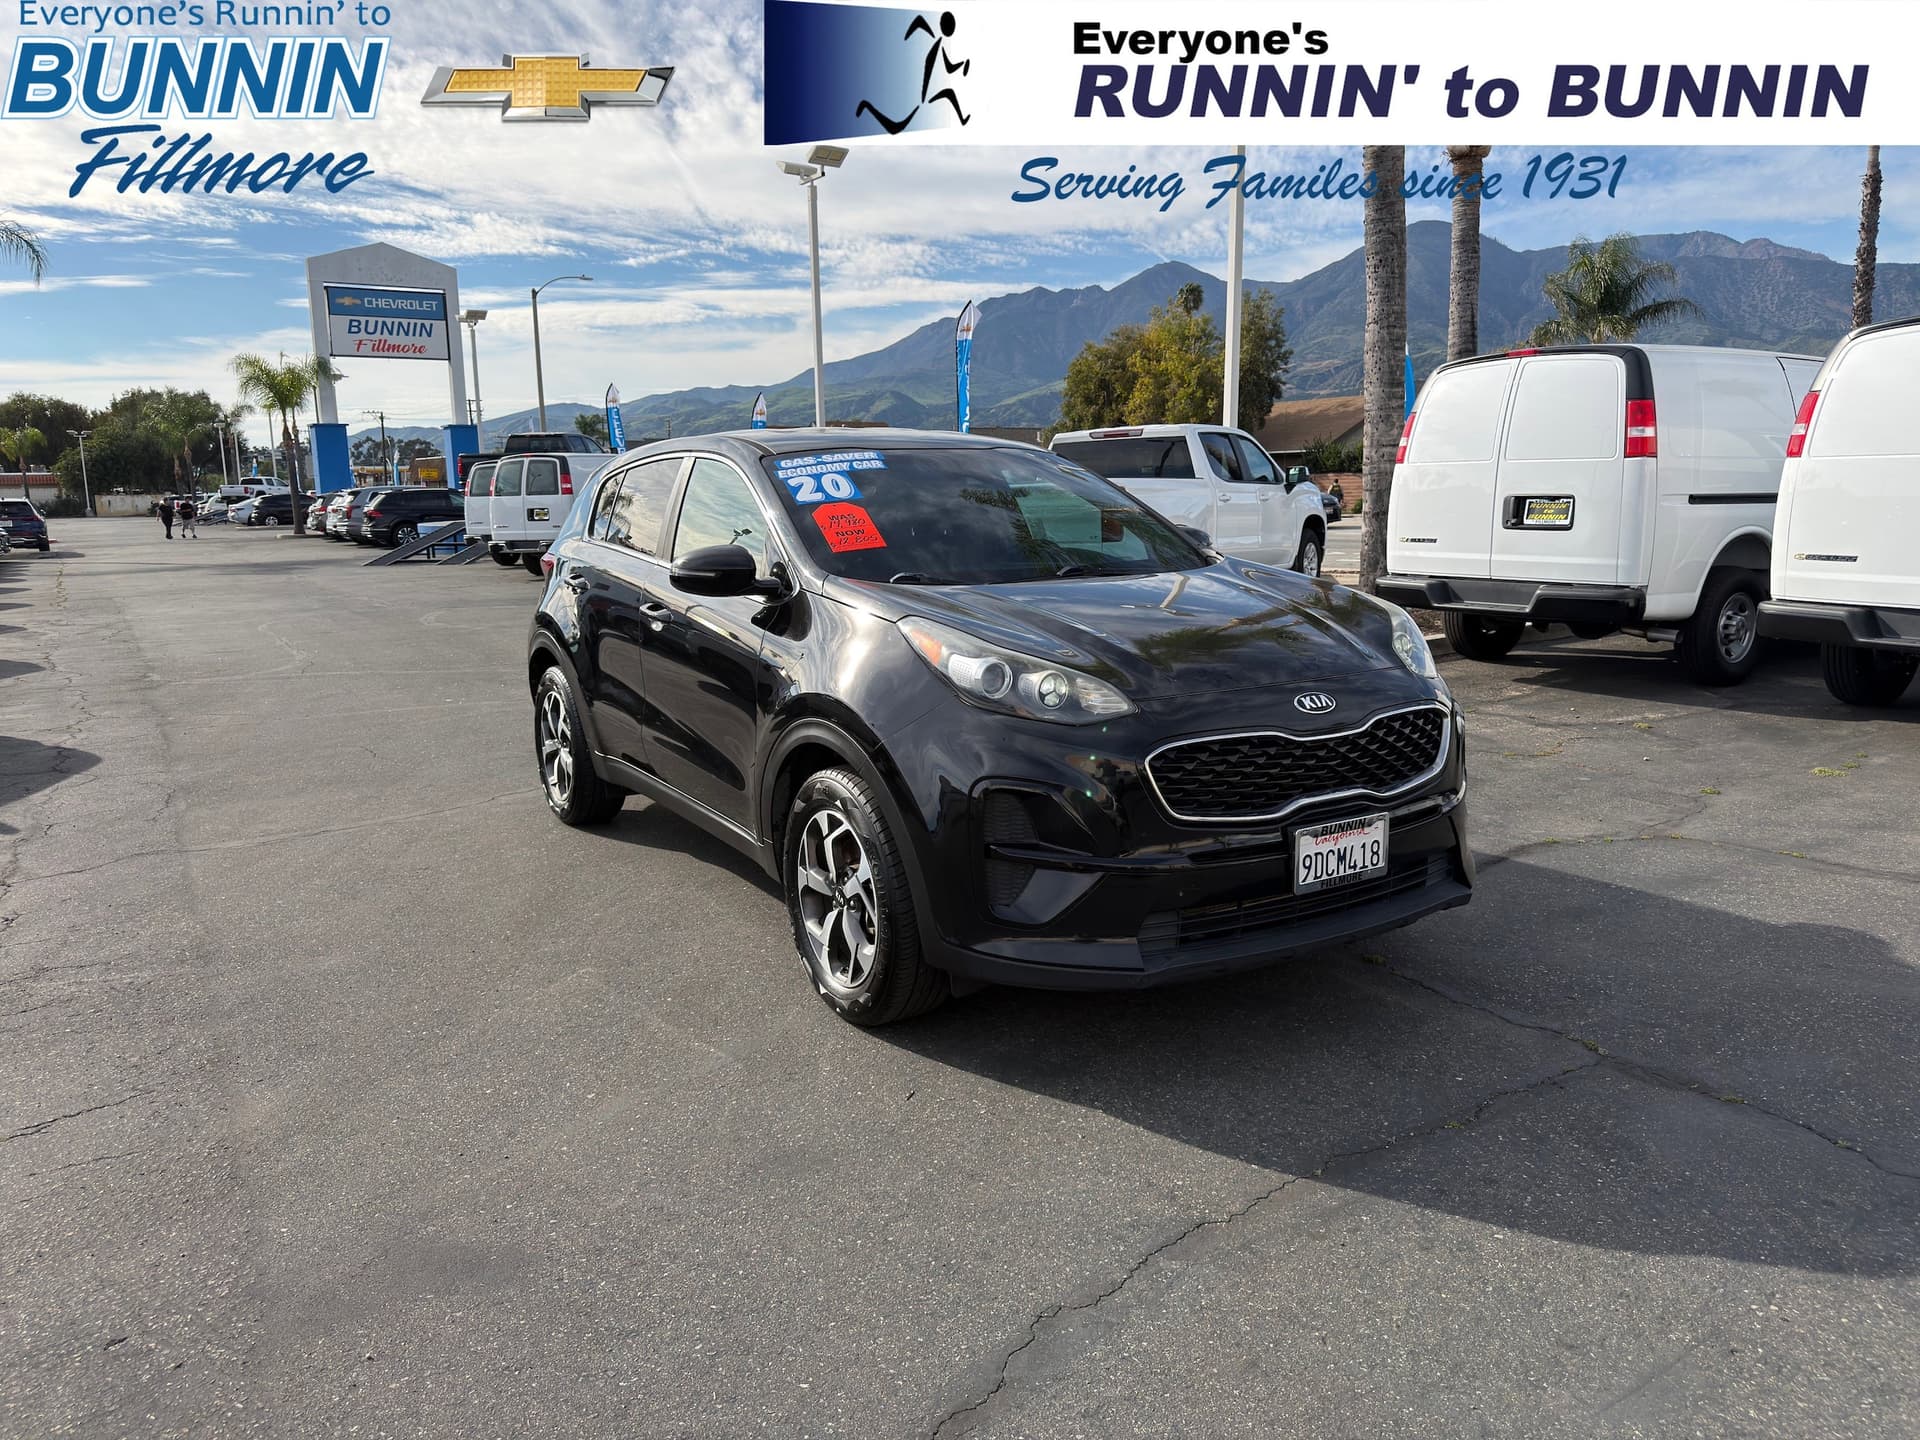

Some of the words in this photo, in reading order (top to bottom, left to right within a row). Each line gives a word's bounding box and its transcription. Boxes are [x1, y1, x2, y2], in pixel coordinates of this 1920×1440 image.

[364, 297, 438, 311] CHEVROLET
[347, 319, 434, 337] BUNNIN
[353, 338, 428, 354] Fillmore
[780, 452, 879, 468] GAS-SAVER
[777, 462, 851, 478] ECONOMY
[852, 460, 882, 469] CAR
[787, 472, 855, 502] 20
[828, 513, 856, 521] WAS
[836, 529, 865, 537] NOW
[1300, 695, 1333, 710] KIA
[1320, 818, 1367, 836] BUNNIN
[1301, 839, 1381, 884] 9DCM418
[1321, 872, 1363, 889] FILLMORE
